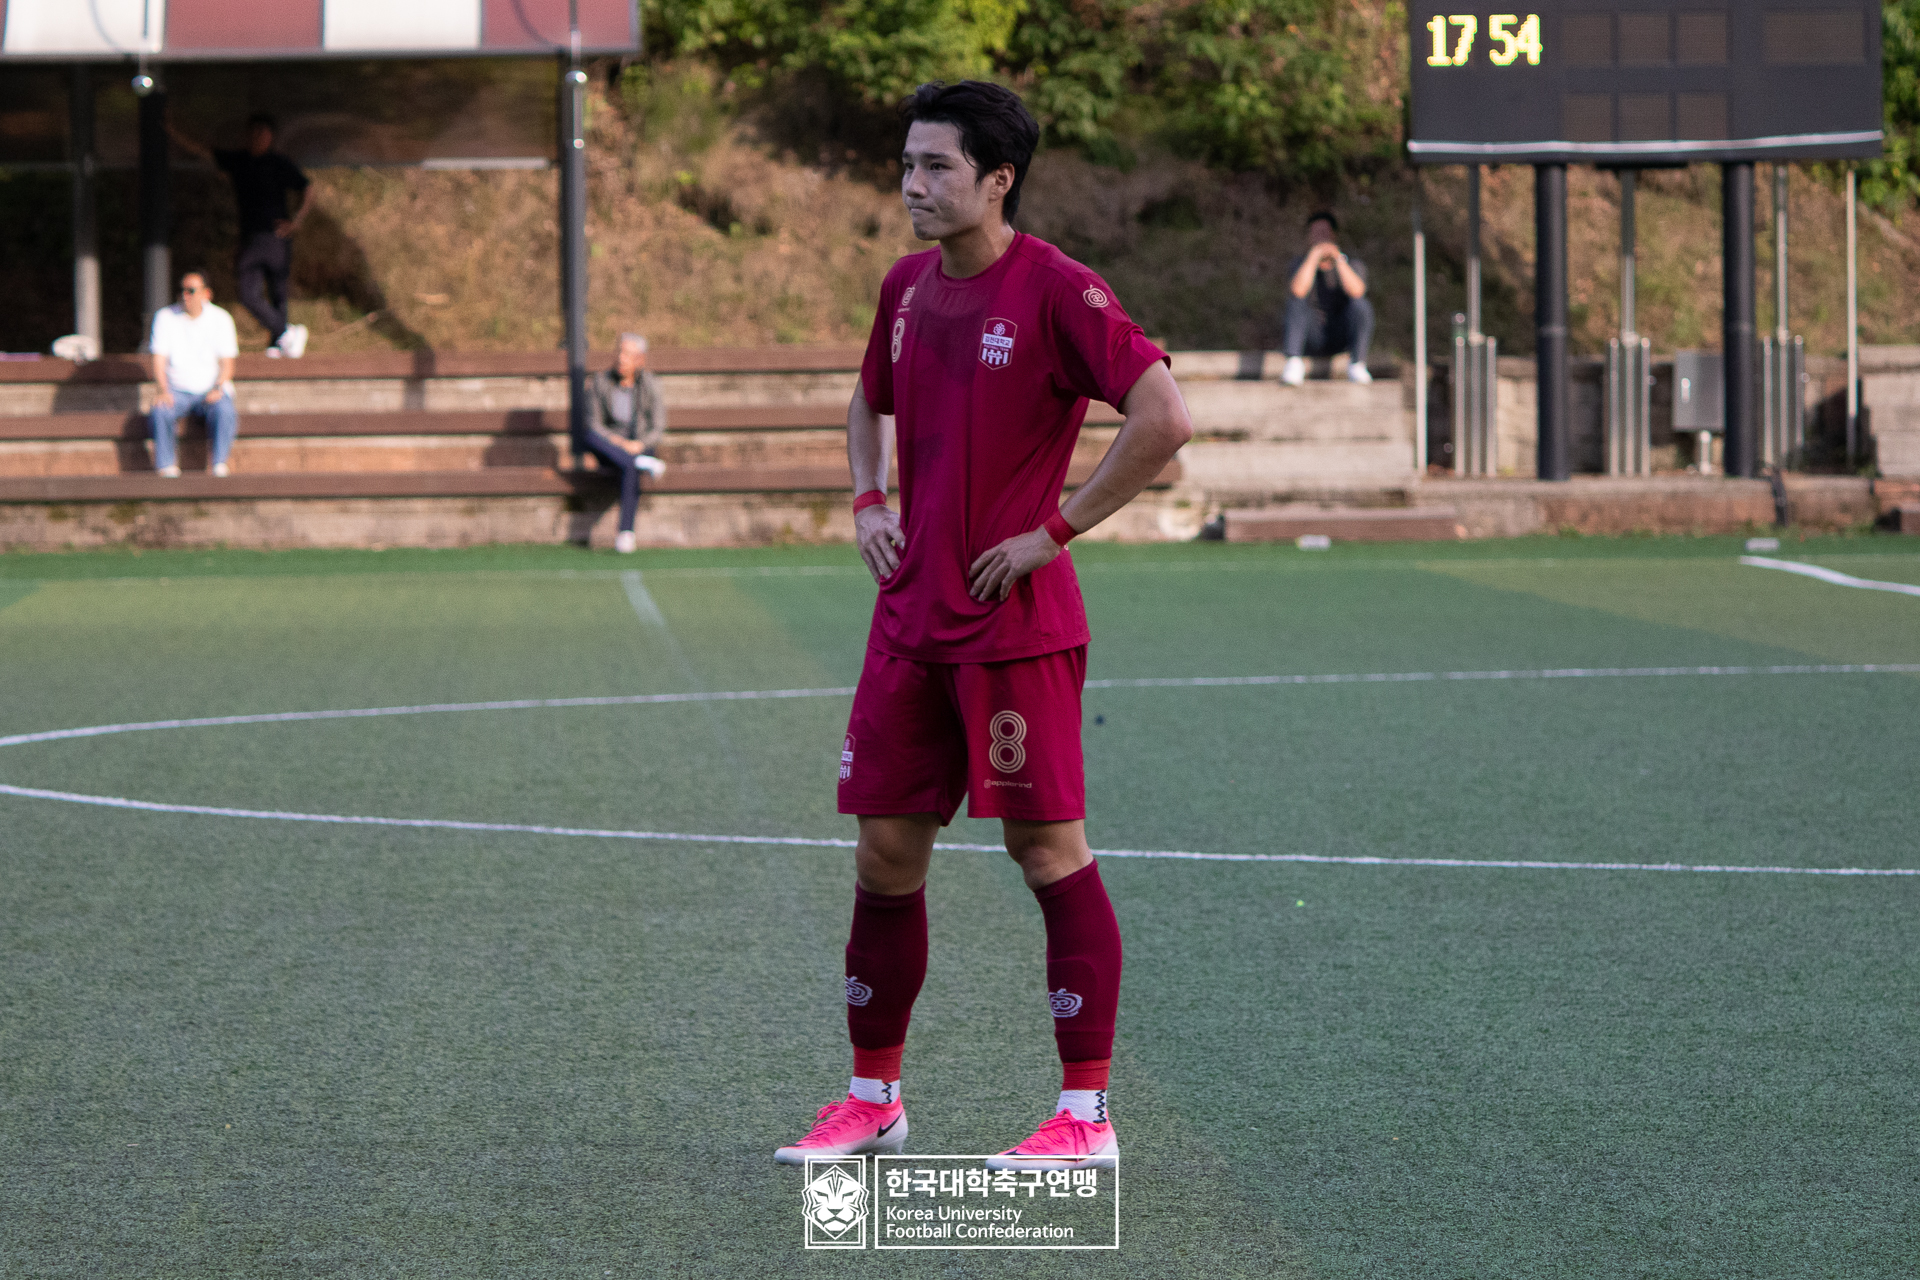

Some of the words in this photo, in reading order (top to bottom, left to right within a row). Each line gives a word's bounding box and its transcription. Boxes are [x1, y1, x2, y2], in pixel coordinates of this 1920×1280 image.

[1427, 14, 1477, 67] 17
[1489, 14, 1543, 66] 54
[891, 318, 905, 362] 8
[989, 710, 1027, 773] 8
